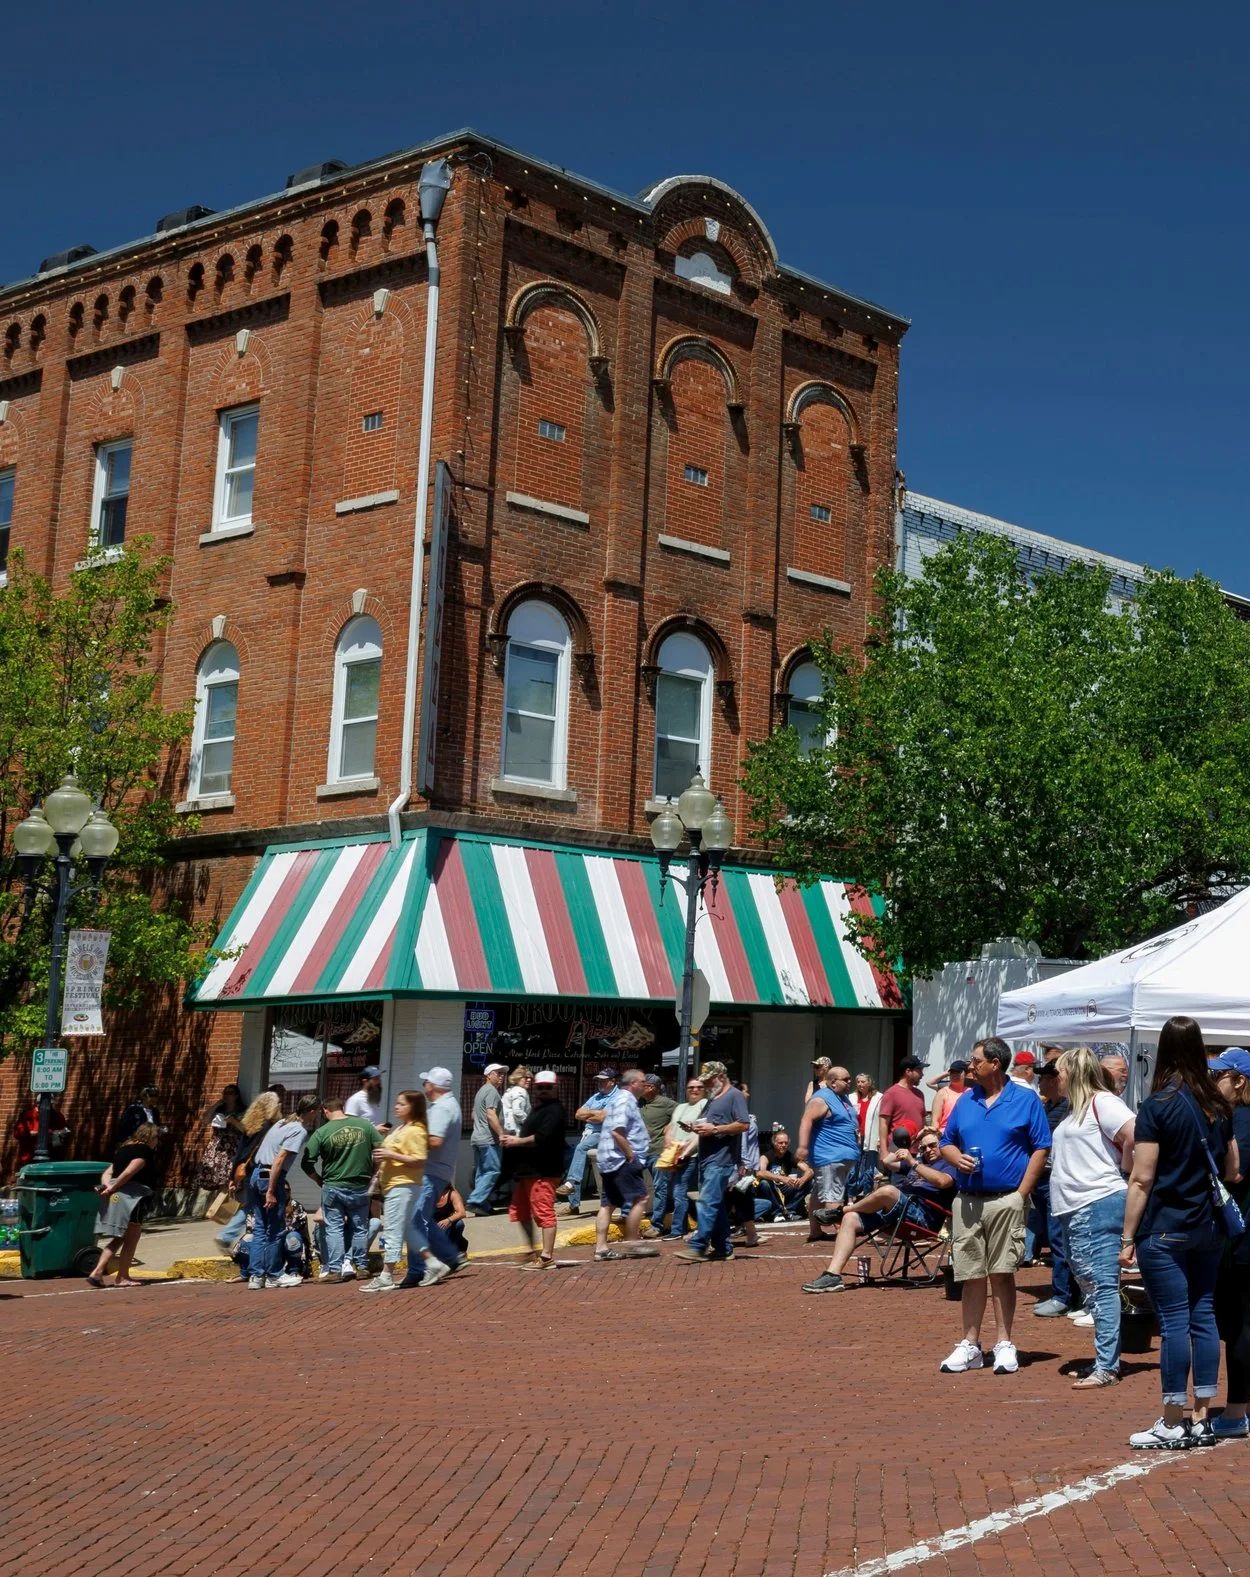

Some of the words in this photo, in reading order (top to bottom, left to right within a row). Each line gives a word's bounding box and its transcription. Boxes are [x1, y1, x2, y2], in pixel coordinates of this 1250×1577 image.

[66, 985, 101, 993] SPRING
[470, 1012, 489, 1021] BUD
[466, 1020, 493, 1029] LIGHT
[463, 1042, 493, 1055] OPEN
[36, 1052, 44, 1063] 3
[552, 1063, 577, 1075] Catering
